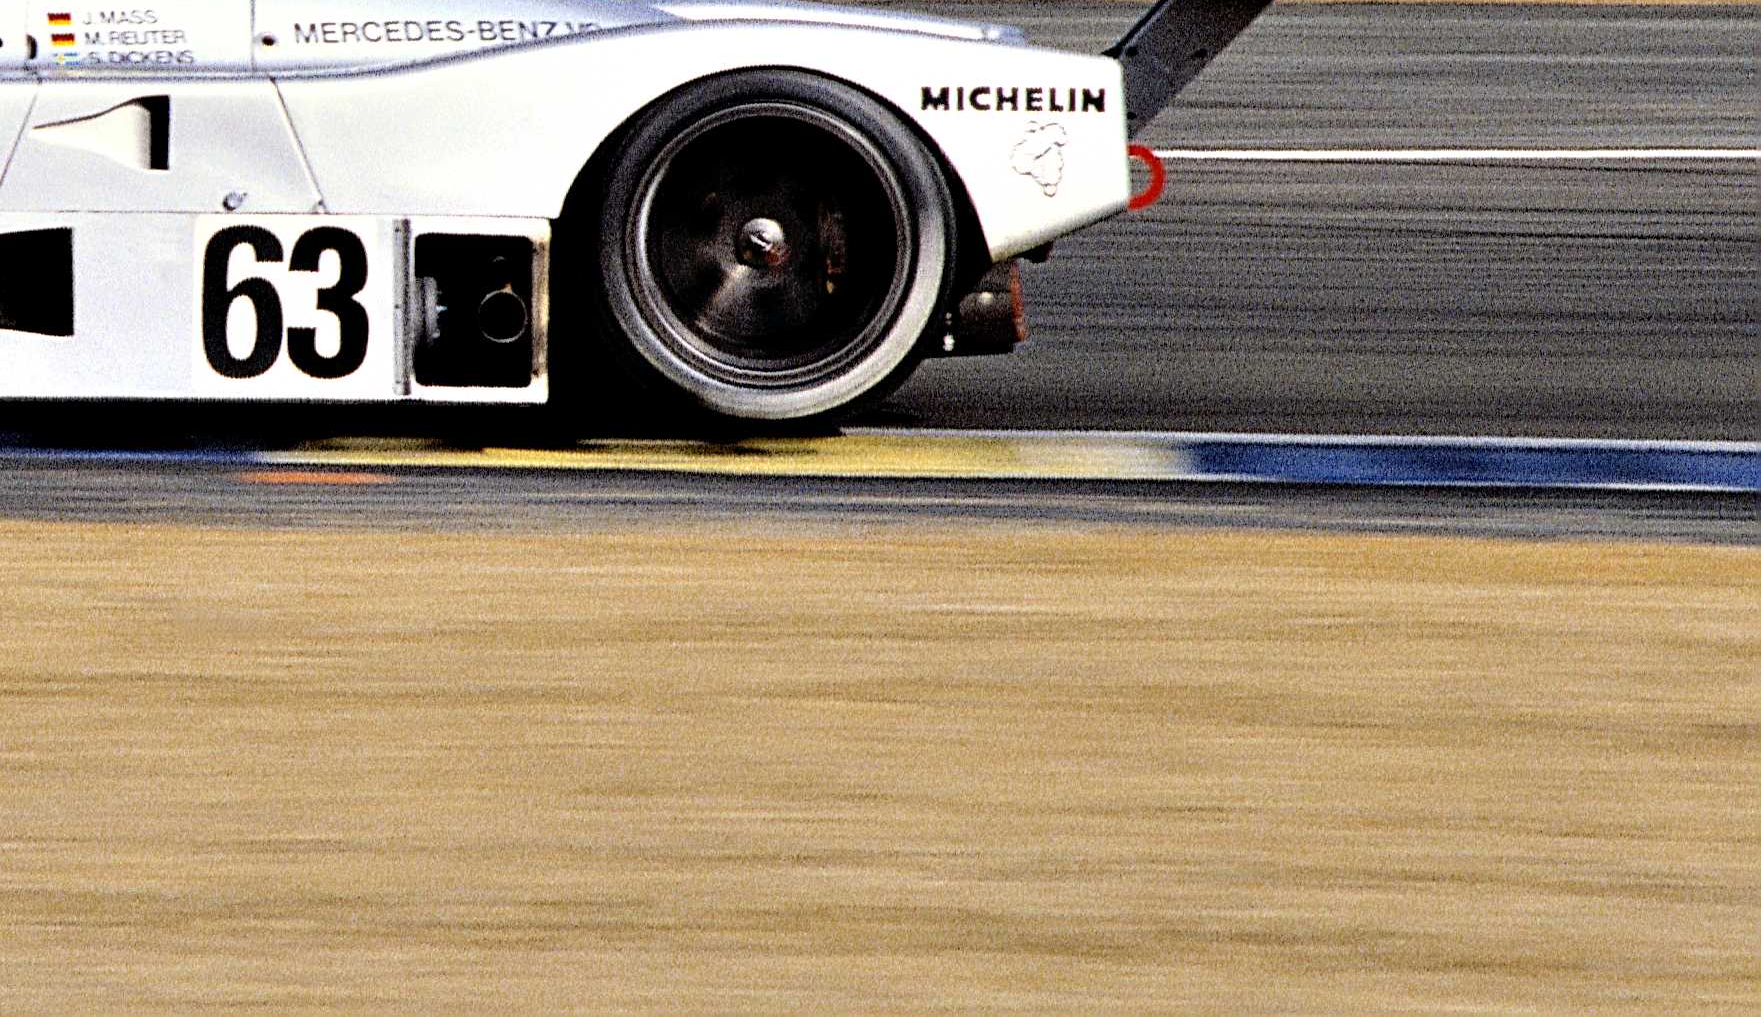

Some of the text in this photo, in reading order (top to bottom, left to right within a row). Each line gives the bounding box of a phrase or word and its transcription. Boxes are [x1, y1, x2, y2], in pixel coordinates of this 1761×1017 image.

[99, 9, 158, 25] MASS
[108, 29, 186, 45] REUTER
[294, 20, 558, 43] MERCEDES-BENZ
[107, 49, 196, 65] DICKENS
[921, 86, 1106, 113] MICHELIN
[202, 225, 369, 379] 63
